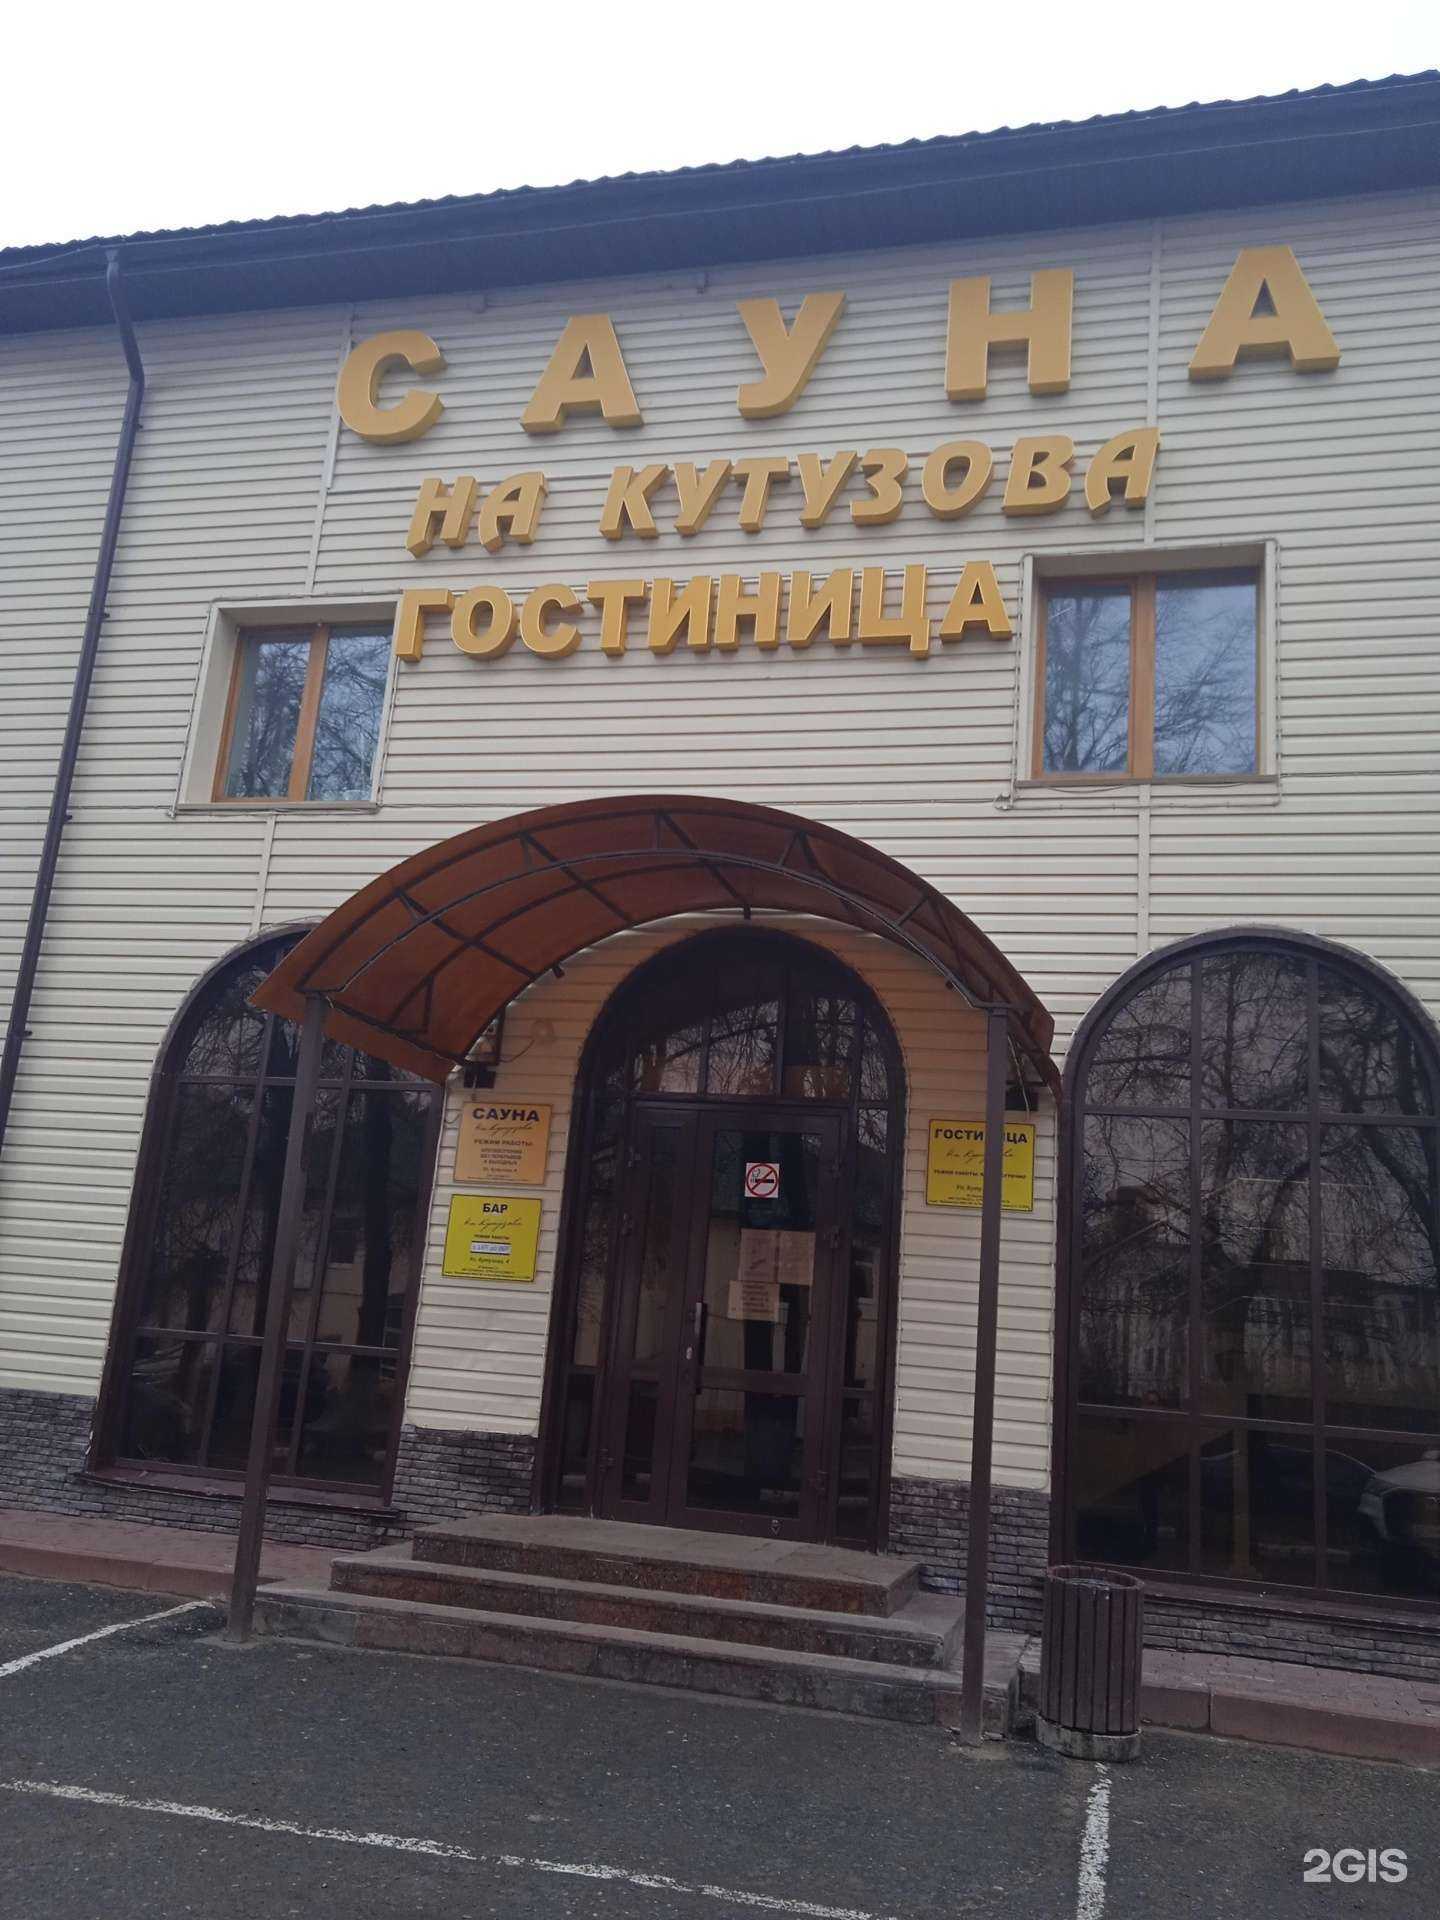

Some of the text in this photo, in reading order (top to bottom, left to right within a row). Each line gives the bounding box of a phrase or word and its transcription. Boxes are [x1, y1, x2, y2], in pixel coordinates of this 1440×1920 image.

[336, 245, 1340, 446] САУНА
[406, 427, 1160, 558] НА КУТУЗОВА
[397, 560, 1011, 661] ГОСТИНИЦА
[472, 1108, 540, 1121] САУНА
[934, 1128, 1028, 1144] ГОСТИЦА
[482, 1203, 509, 1213] БАР
